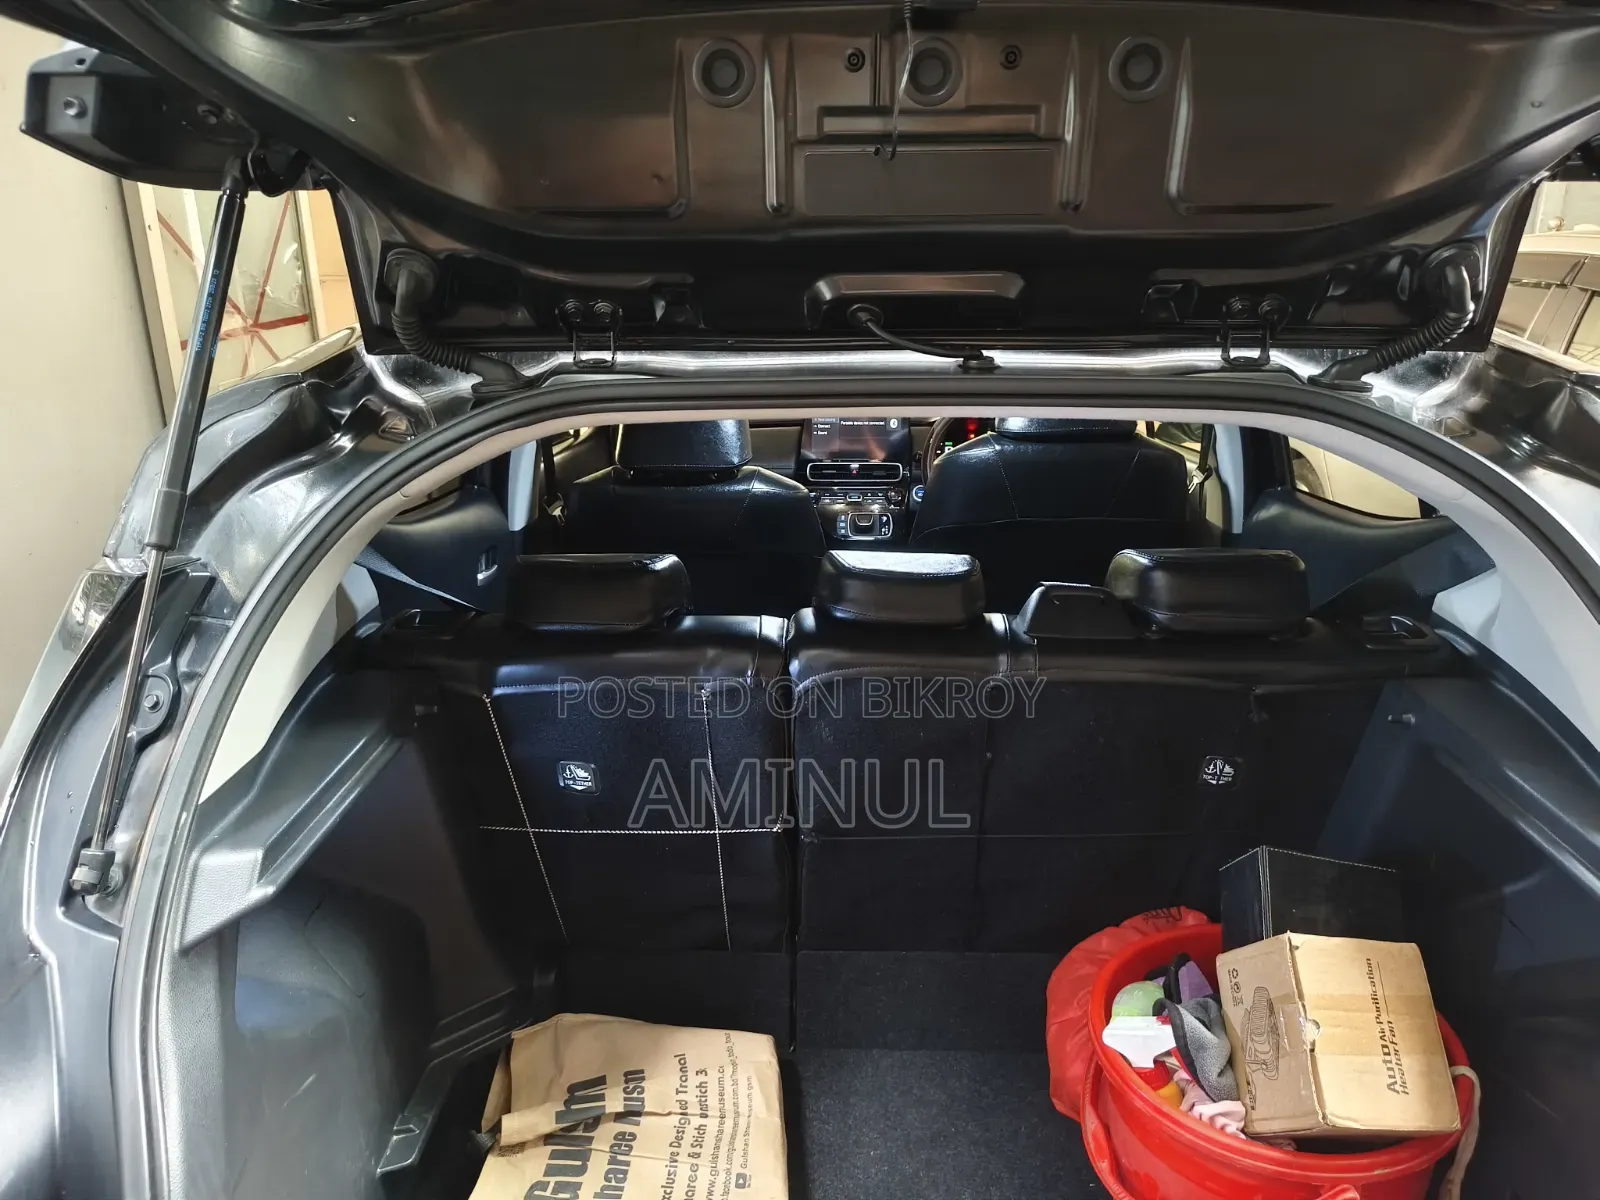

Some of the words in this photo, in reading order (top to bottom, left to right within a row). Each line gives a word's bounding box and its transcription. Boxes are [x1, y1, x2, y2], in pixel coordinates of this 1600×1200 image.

[1365, 957, 1384, 1025] Purification
[1387, 1020, 1398, 1046] Fan
[1392, 1046, 1410, 1096] Heater
[660, 1151, 680, 1200] xclusive
[688, 1151, 702, 1159] &
